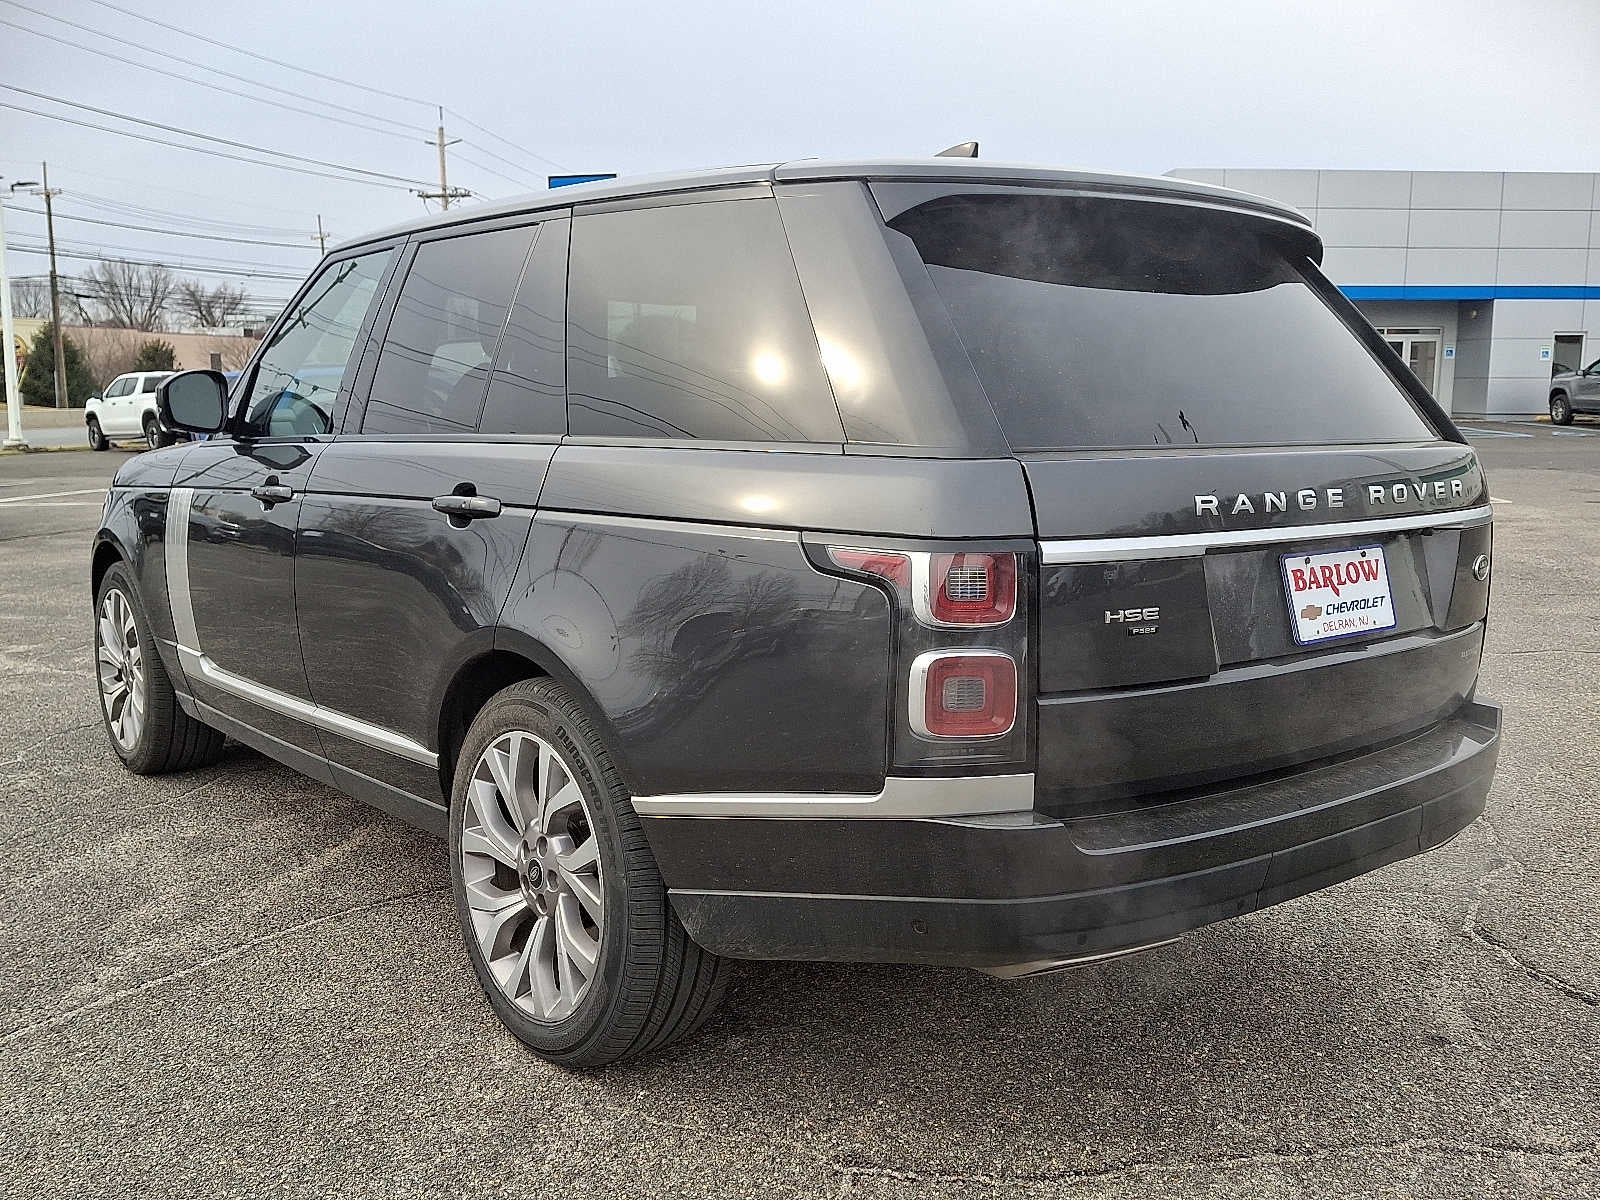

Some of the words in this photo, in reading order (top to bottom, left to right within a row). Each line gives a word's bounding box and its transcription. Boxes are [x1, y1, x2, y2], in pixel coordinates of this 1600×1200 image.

[1194, 488, 1344, 516] RANGE
[1368, 479, 1463, 505] ROVER
[1291, 559, 1379, 597] BARLOW
[1326, 596, 1385, 615] CHEVROLET
[1104, 607, 1160, 624] HSE
[1323, 618, 1358, 633] DELRAN,
[1358, 616, 1369, 626] NJ
